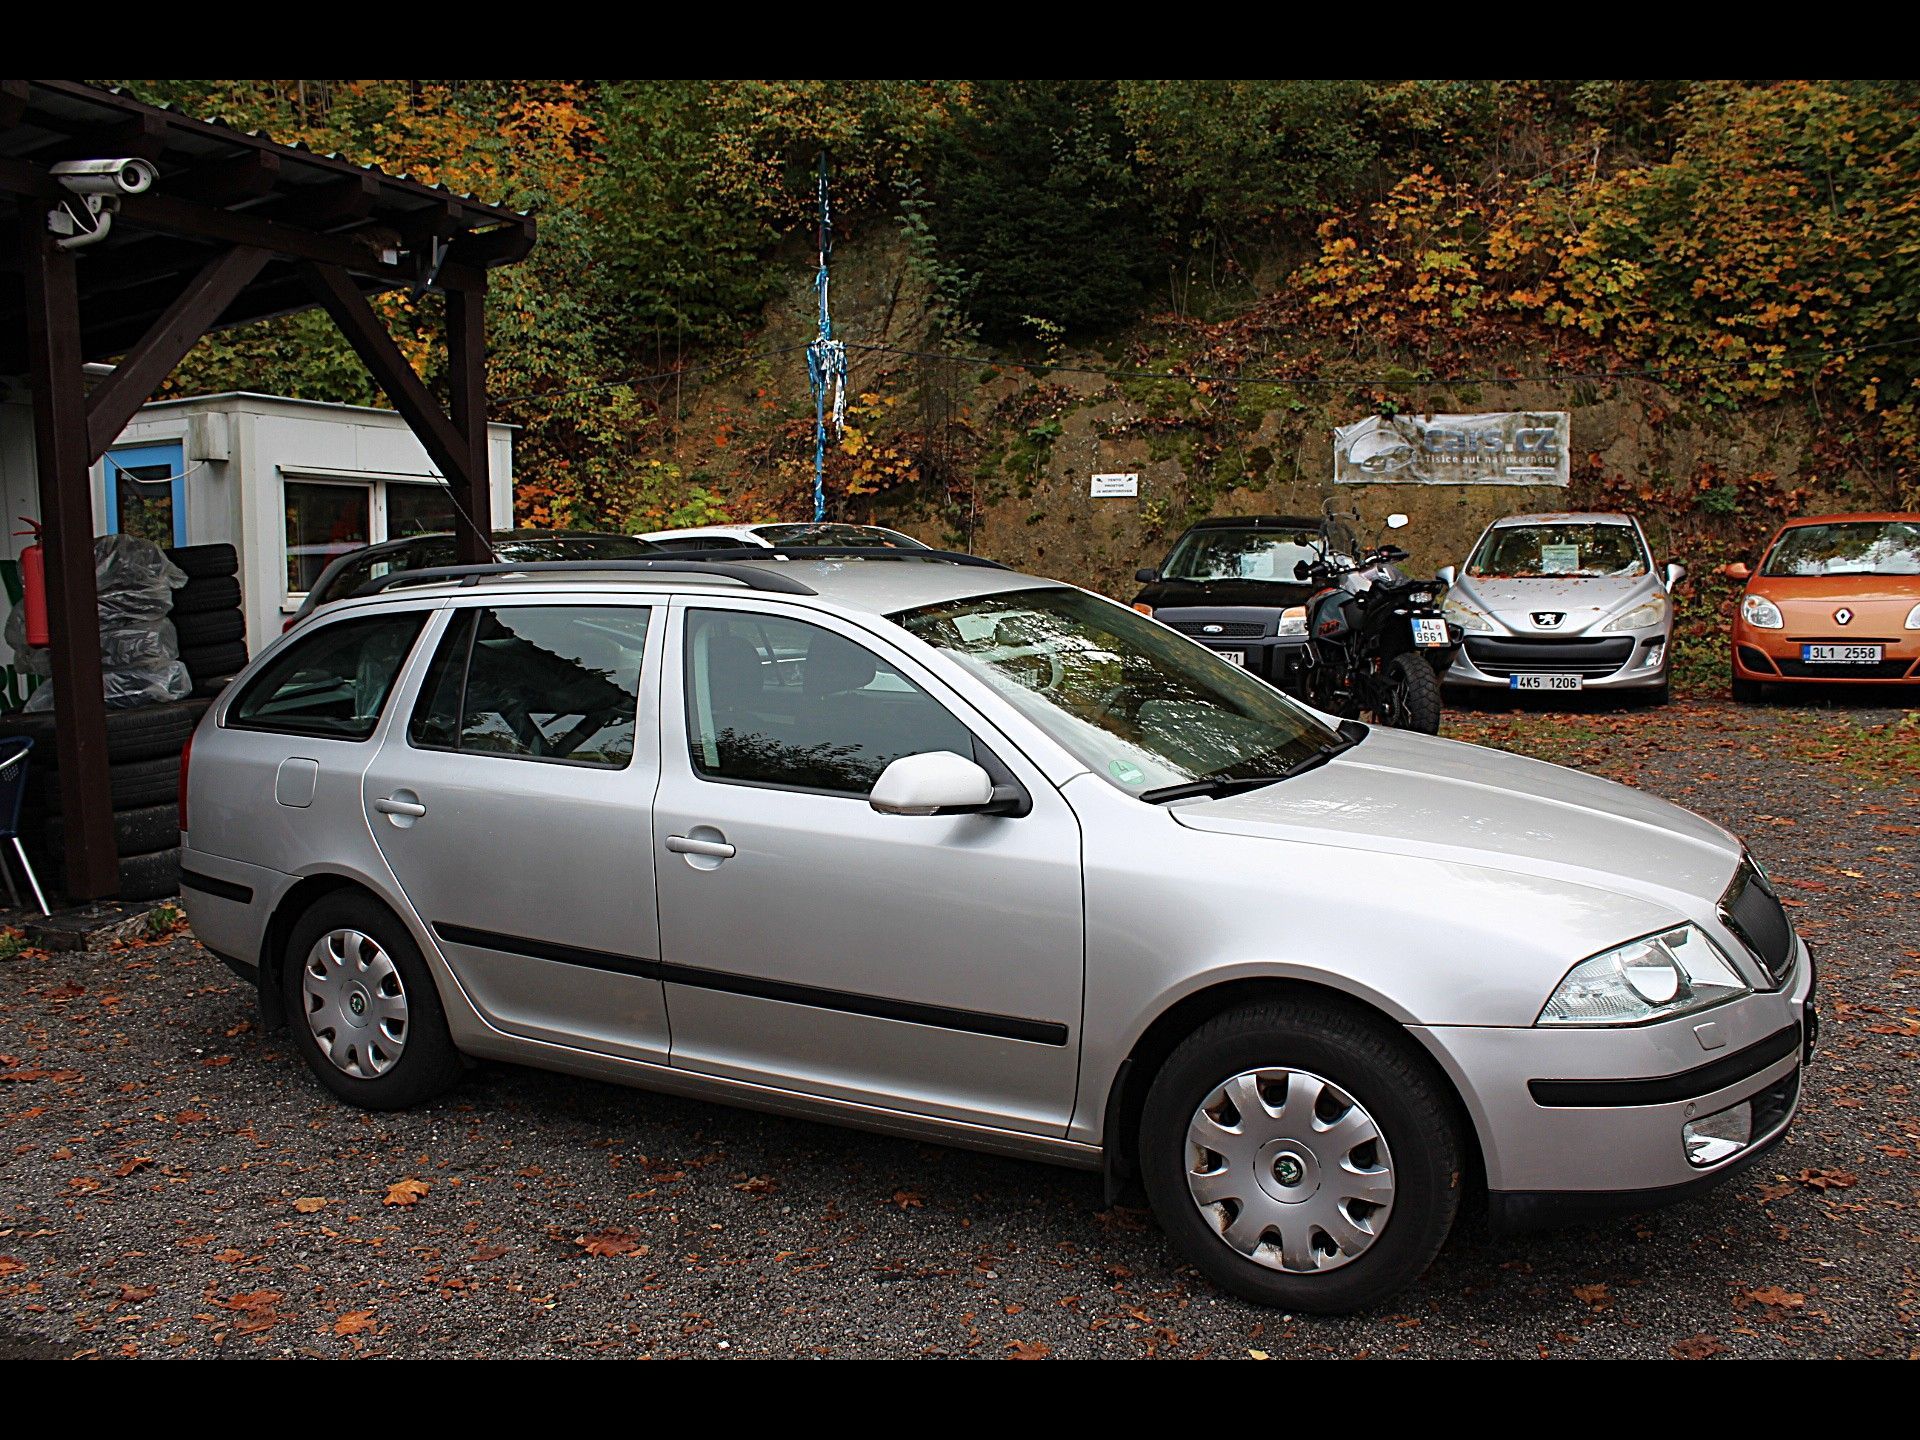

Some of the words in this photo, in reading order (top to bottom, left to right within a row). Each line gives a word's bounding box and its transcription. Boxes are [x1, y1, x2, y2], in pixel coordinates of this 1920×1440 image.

[1462, 454, 1480, 464] aut
[1485, 455, 1498, 464] na
[1502, 454, 1557, 464] internetu
[1422, 621, 1434, 630] 4L
[1416, 632, 1442, 642] 9661
[1812, 647, 1835, 659] 3L1
[1844, 647, 1876, 659] 2558
[1519, 677, 1540, 688] 4K5
[1549, 677, 1577, 689] 1206
